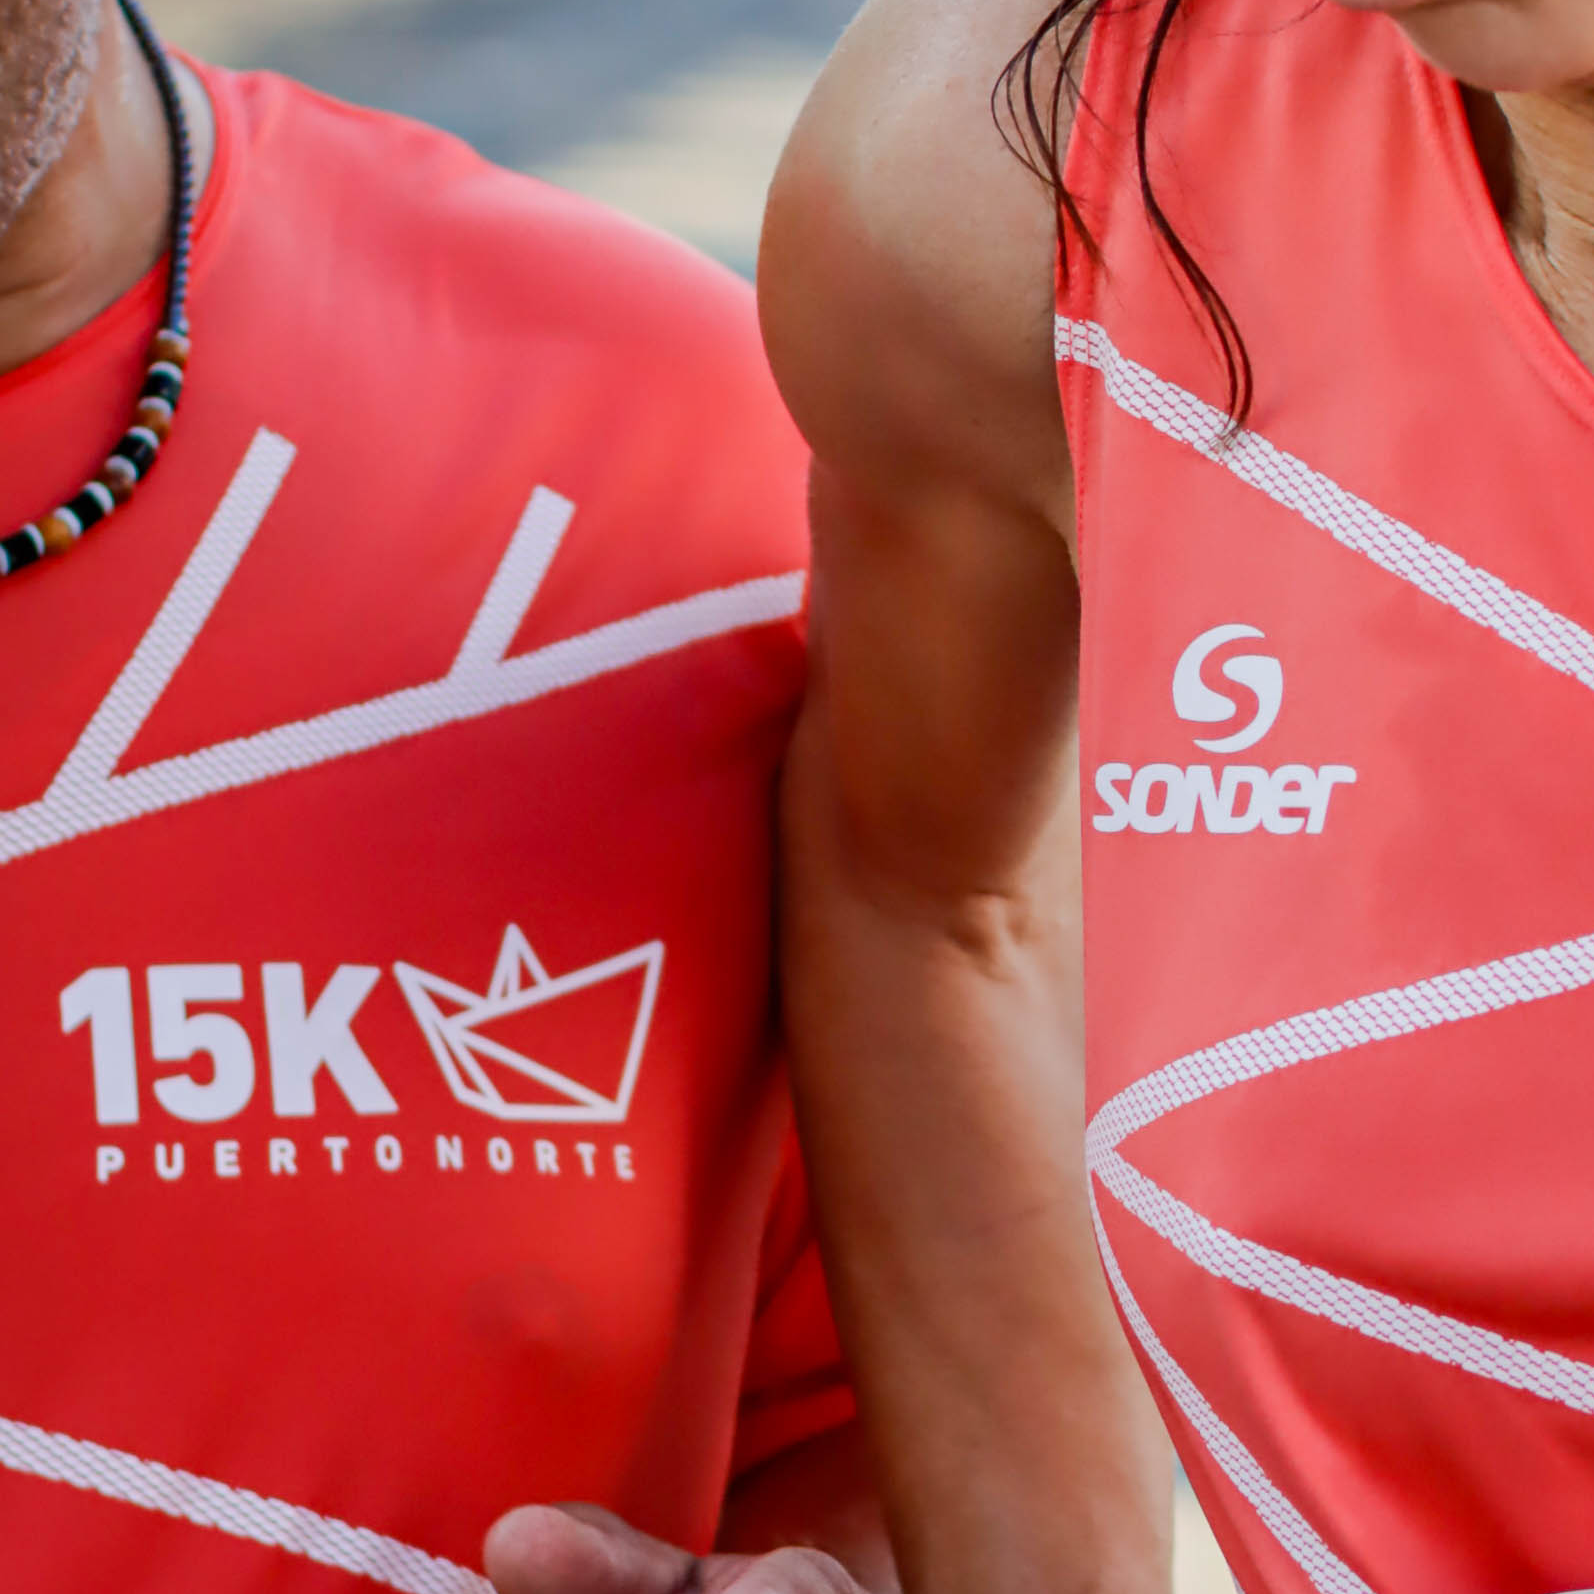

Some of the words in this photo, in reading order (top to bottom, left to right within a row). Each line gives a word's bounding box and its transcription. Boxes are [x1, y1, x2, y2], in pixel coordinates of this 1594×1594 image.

[60, 961, 398, 1124] 15K
[97, 1136, 401, 1183] PUERTO
[437, 1135, 635, 1181] NORTE
